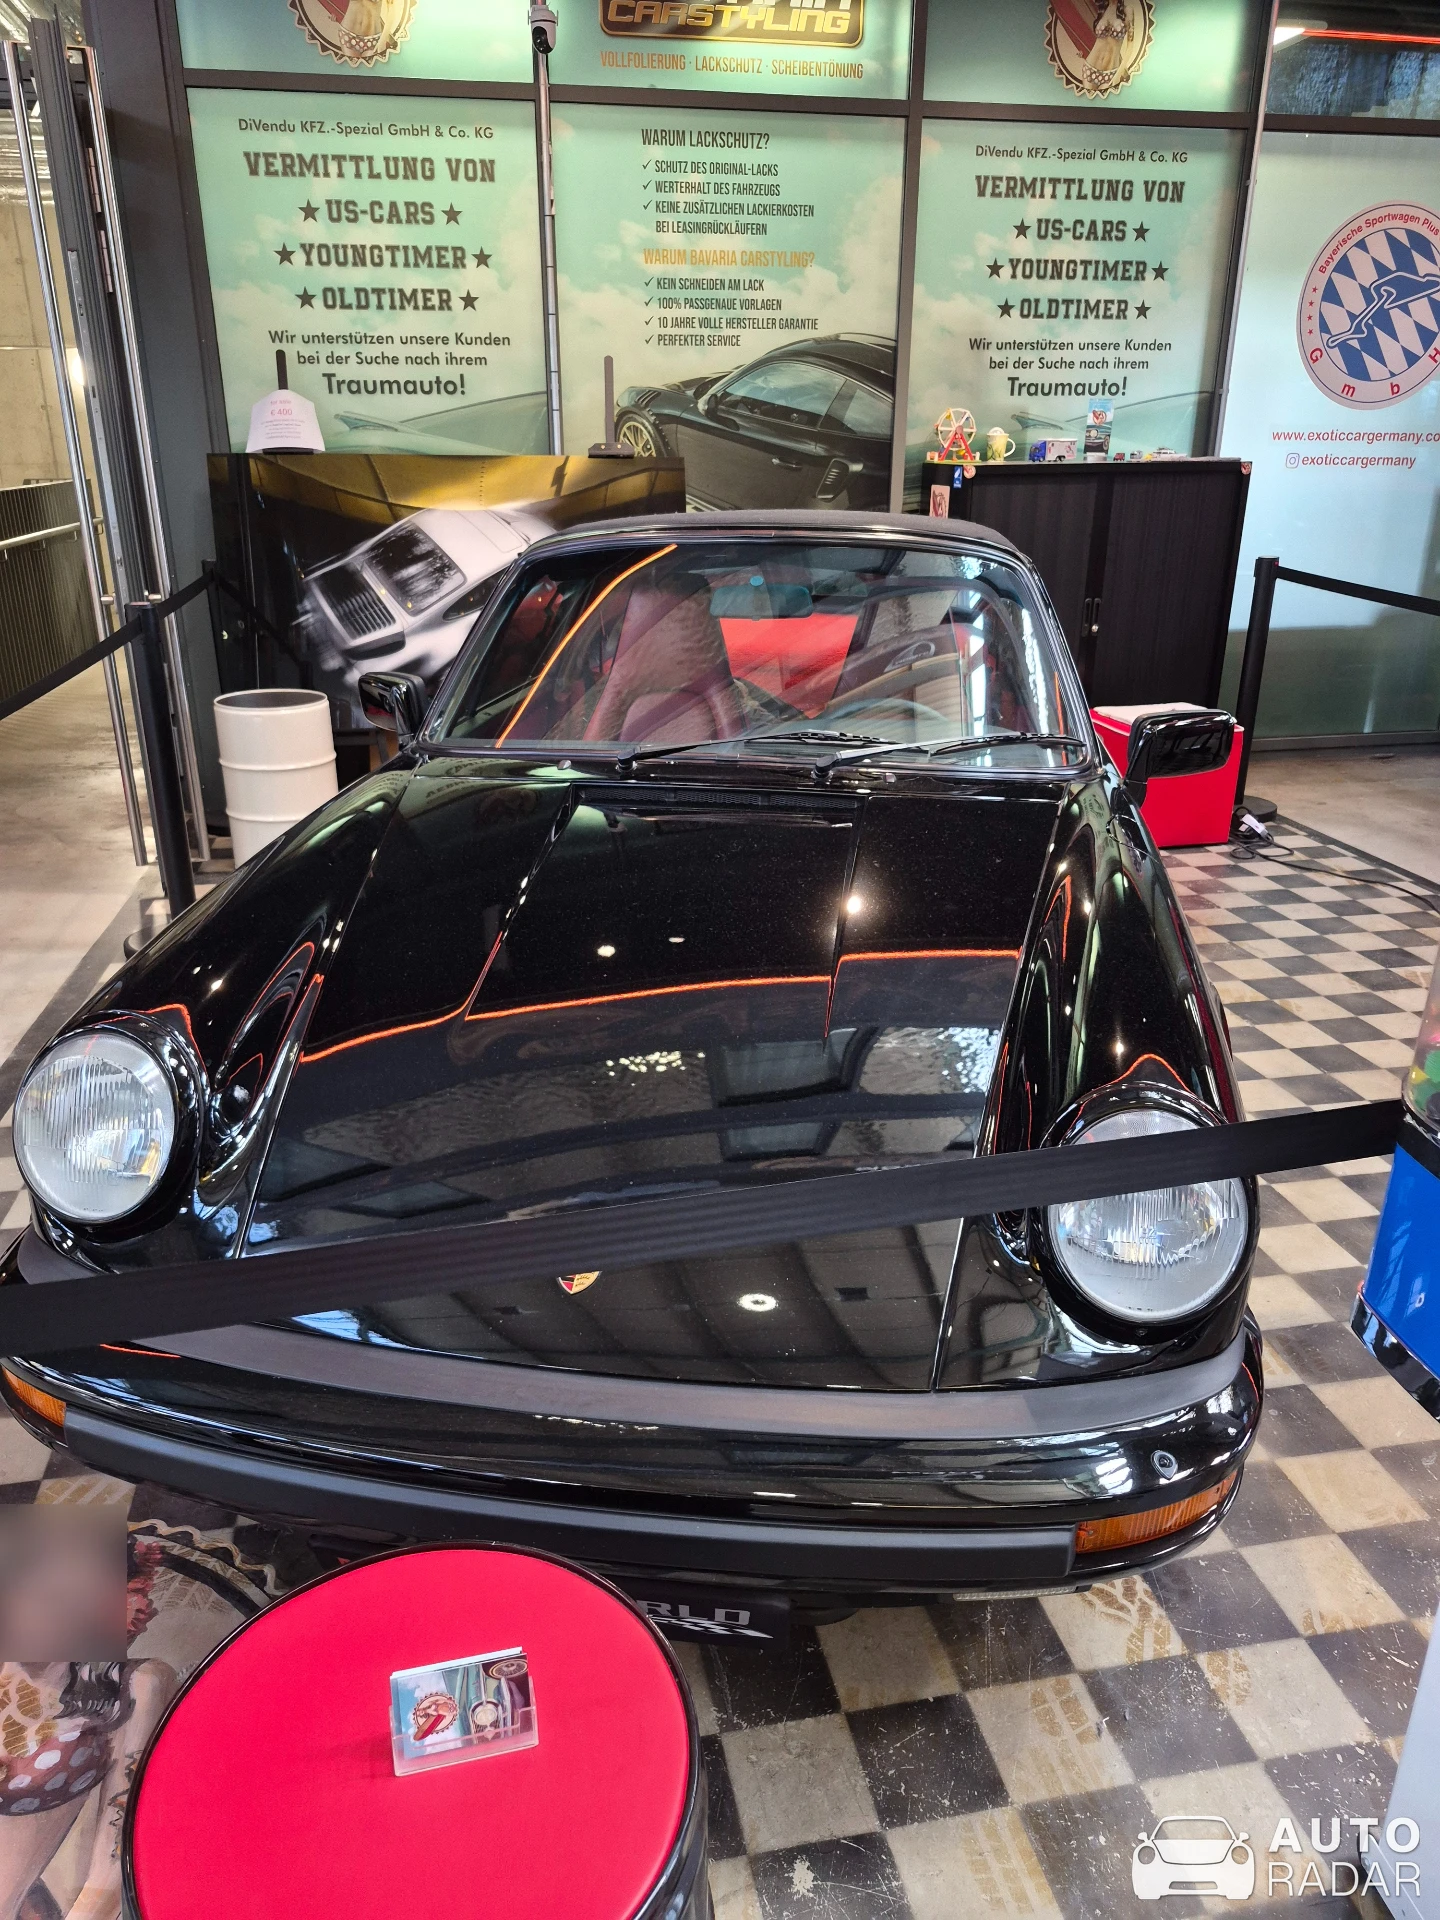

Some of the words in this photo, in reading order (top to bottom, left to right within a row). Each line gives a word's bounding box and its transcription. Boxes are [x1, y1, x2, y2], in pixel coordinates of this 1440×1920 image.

[608, 1, 850, 34] CARSTYLING
[601, 51, 685, 70] VOLLFOLIERUNG
[696, 56, 761, 74] LACKSCHUTZ
[772, 59, 863, 79] SCHEIBENTÖNUNG
[238, 119, 295, 133] DiVendu
[300, 121, 383, 136] KFZ.-Spezial
[388, 124, 429, 137] GmbH
[435, 126, 444, 138] &
[448, 126, 470, 138] Co.
[475, 126, 494, 138] KG
[642, 129, 685, 147] WARUM
[690, 130, 770, 150] LACKSCHUTZ?
[976, 145, 1022, 158] DiVendu
[1027, 148, 1096, 162] KFZ.-Spezial
[1100, 150, 1135, 161] GmbH
[1139, 151, 1146, 161] &
[1150, 151, 1168, 162] Co.
[1172, 152, 1188, 163] KG
[243, 151, 435, 180] VERMITTLUNG
[445, 158, 495, 182] VON
[655, 160, 688, 174] SCHUTZ
[691, 161, 707, 175] DES
[710, 162, 778, 177] ORIGINAL-LACKS
[655, 181, 711, 194] WERTERHALT
[714, 182, 730, 195] DES
[732, 183, 780, 197] FAHRZEUGS
[975, 175, 1133, 200] VERMITTLUNG
[1143, 180, 1185, 202] VON
[325, 199, 435, 225] US-CARS
[656, 201, 680, 214] KEINE
[683, 200, 744, 216] ZUSÄTZLICHEN
[747, 204, 814, 217] LACKIERKOSTEN
[656, 221, 670, 233] BEI
[672, 220, 767, 236] LEASINGRÜCKLÄUFERN
[1036, 218, 1127, 241] US-CARS
[1318, 224, 1363, 274] Bayerische
[1364, 213, 1420, 228] Sportwagen
[1422, 218, 1439, 235] Plus
[299, 243, 467, 269] YOUNGTIMER
[644, 248, 687, 265] WARUM
[690, 249, 737, 265] BAVARIA
[741, 250, 815, 267] CARSTYLING?
[1009, 258, 1147, 281] YOUNGTIMER
[657, 278, 676, 290] KEIN
[678, 278, 725, 290] SCHNEIDEN
[728, 279, 741, 291] AM
[743, 279, 764, 291] LACK
[322, 287, 452, 311] OLDTIMER
[657, 298, 681, 309] 100%
[684, 298, 737, 310] PASSGENAUE
[739, 299, 782, 311] VORLAGEN
[1019, 298, 1128, 320] OLDTIMER
[658, 317, 667, 328] 10
[670, 317, 696, 329] JAHRE
[698, 317, 723, 329] VOLLE
[725, 318, 776, 330] HERSTELLER
[779, 318, 818, 330] GARANTIE
[269, 330, 296, 344] Wir
[301, 331, 394, 345] unterstützen
[400, 334, 449, 345] unsere
[455, 333, 510, 346] Kunden
[658, 335, 705, 346] PERFEKTER
[707, 335, 741, 347] SERVICE
[969, 338, 992, 351] Wir
[996, 338, 1073, 351] unterstützen
[1078, 340, 1120, 351] unsere
[1125, 339, 1171, 351] Kunden
[297, 351, 320, 365] bei
[325, 352, 350, 365] der
[355, 352, 399, 366] Suche
[405, 353, 440, 366] nach
[445, 353, 487, 367] ihrem
[989, 357, 1008, 370] bei
[1013, 357, 1034, 370] der
[1038, 357, 1075, 370] Suche
[1079, 358, 1108, 370] nach
[1113, 358, 1149, 370] ihrem
[322, 372, 465, 396] Traumauto!
[1007, 376, 1127, 397] Traumauto!
[1302, 454, 1416, 468] exoticcargermany
